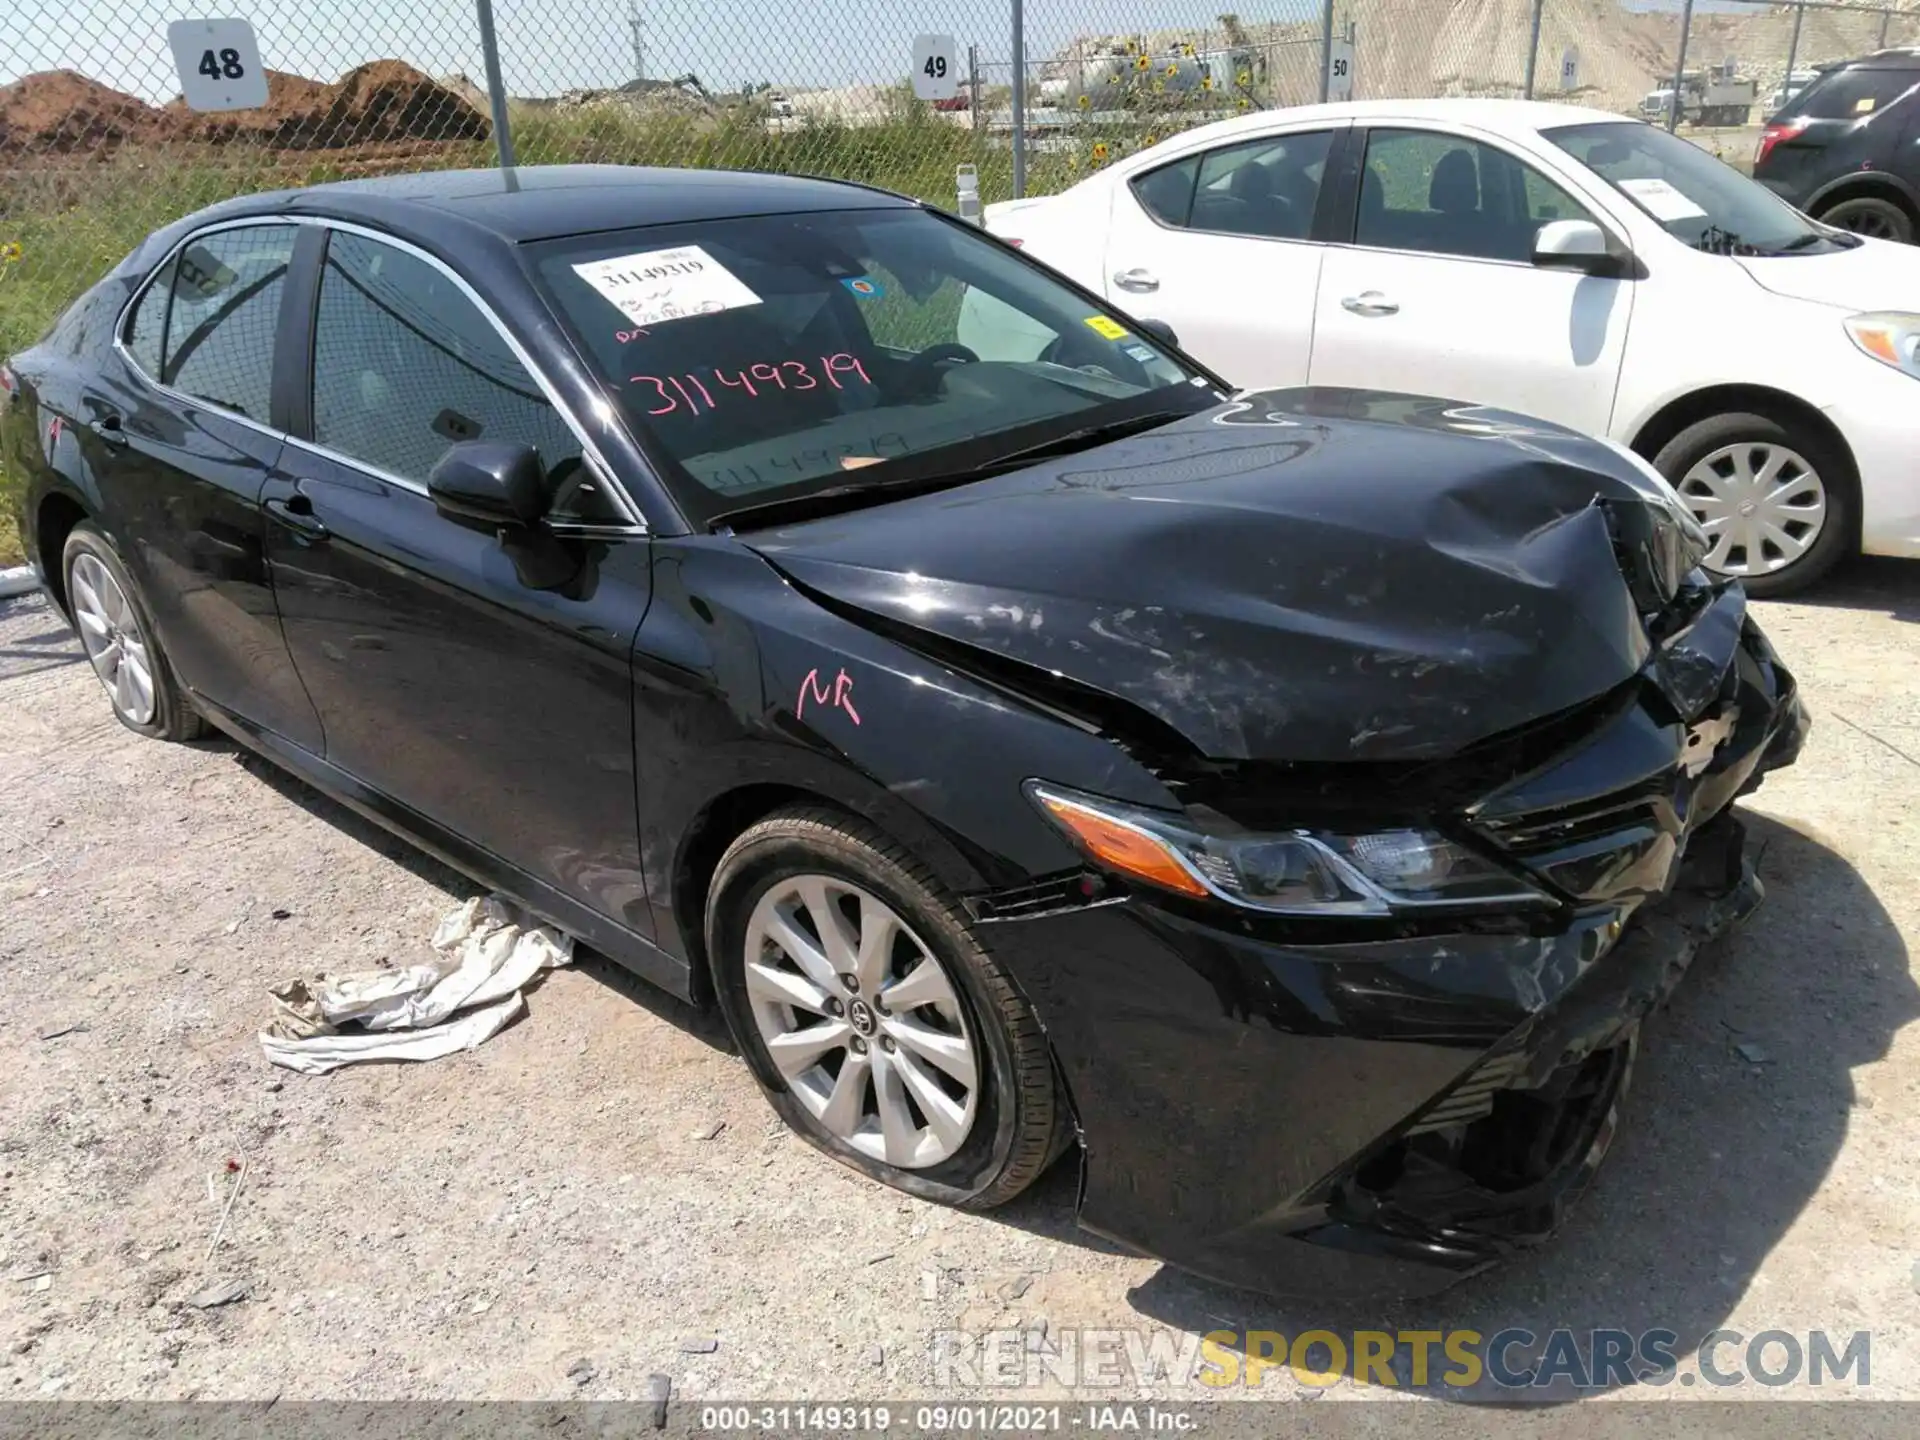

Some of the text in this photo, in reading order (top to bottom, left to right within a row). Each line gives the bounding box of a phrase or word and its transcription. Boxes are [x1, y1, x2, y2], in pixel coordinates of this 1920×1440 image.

[199, 48, 244, 80] 48
[925, 55, 947, 78] 49
[1333, 59, 1348, 76] 50
[602, 260, 704, 288] 31149319
[630, 353, 872, 416] 31149319
